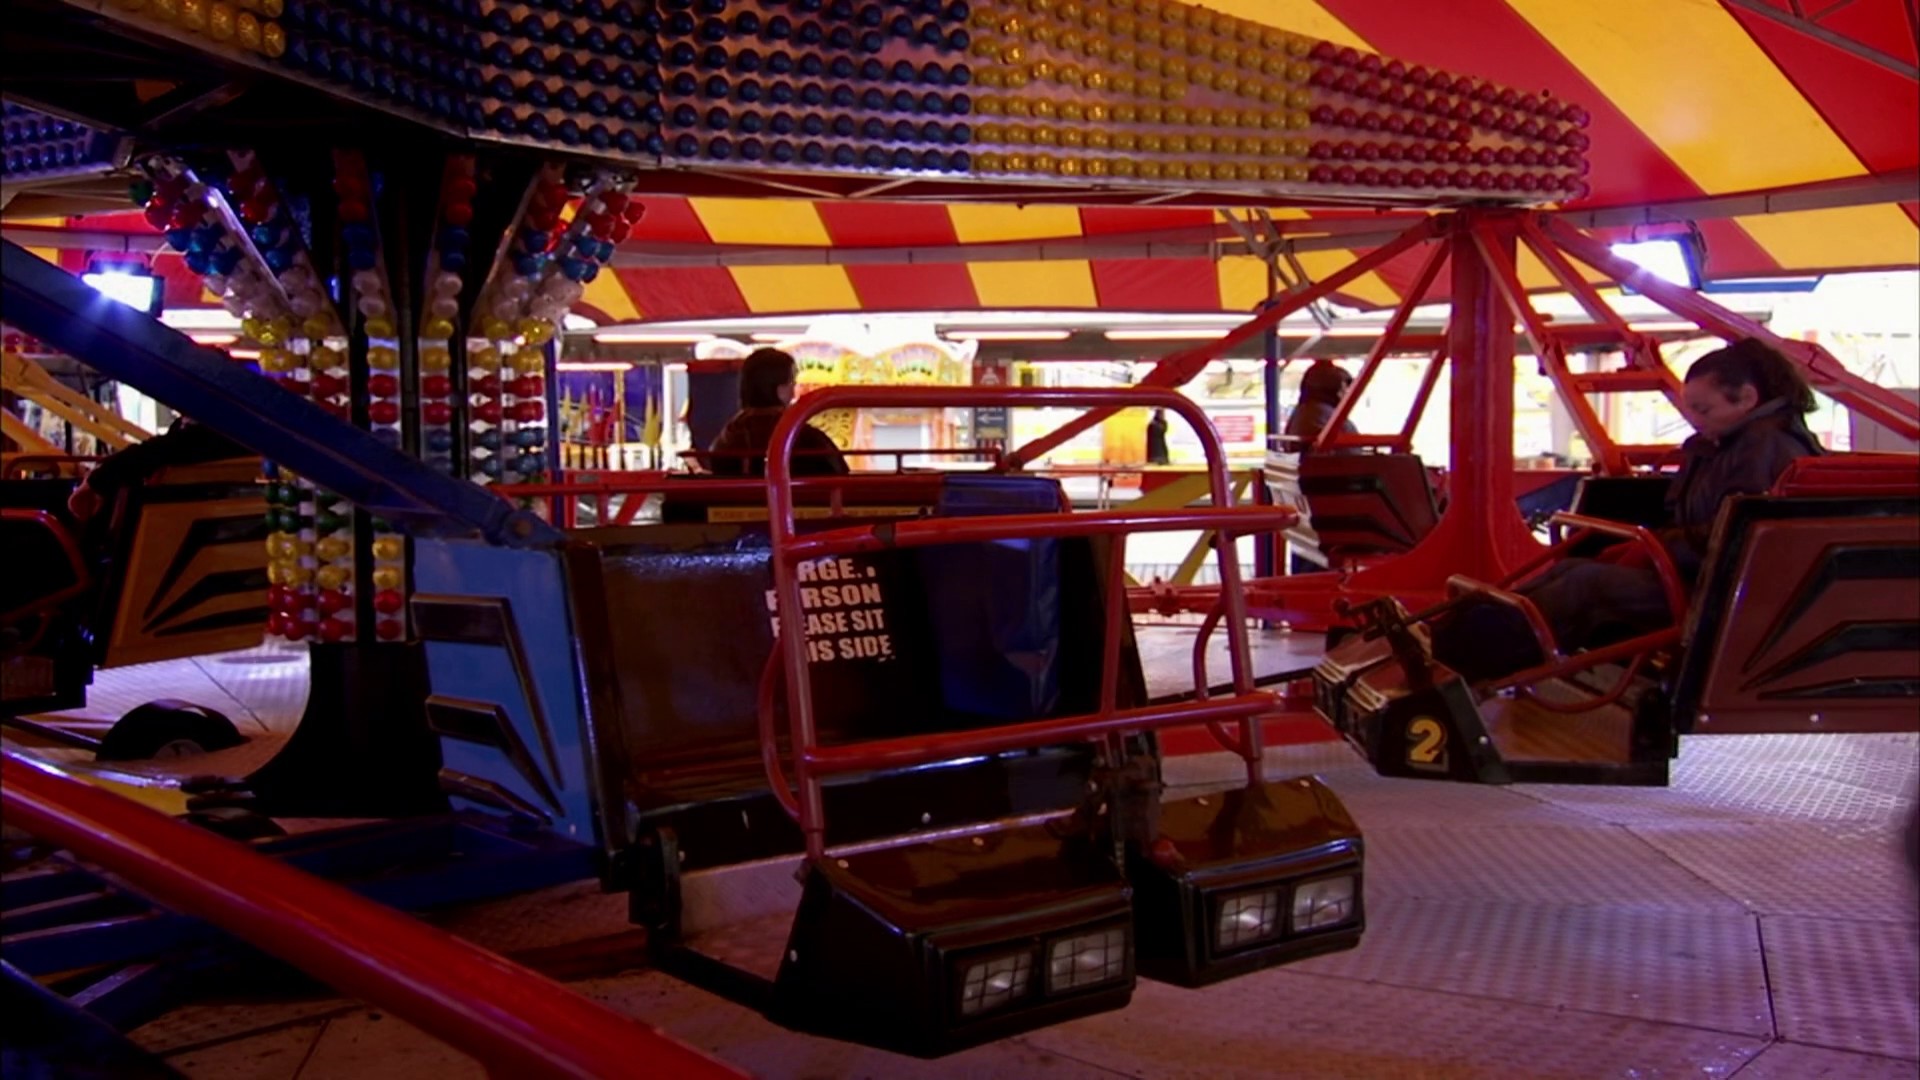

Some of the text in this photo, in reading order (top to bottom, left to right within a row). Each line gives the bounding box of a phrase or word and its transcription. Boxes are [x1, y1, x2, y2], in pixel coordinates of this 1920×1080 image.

[765, 583, 882, 613] PRSON
[770, 609, 885, 639] PASE SIT
[803, 637, 836, 663] IS
[1408, 717, 1445, 766] 2
